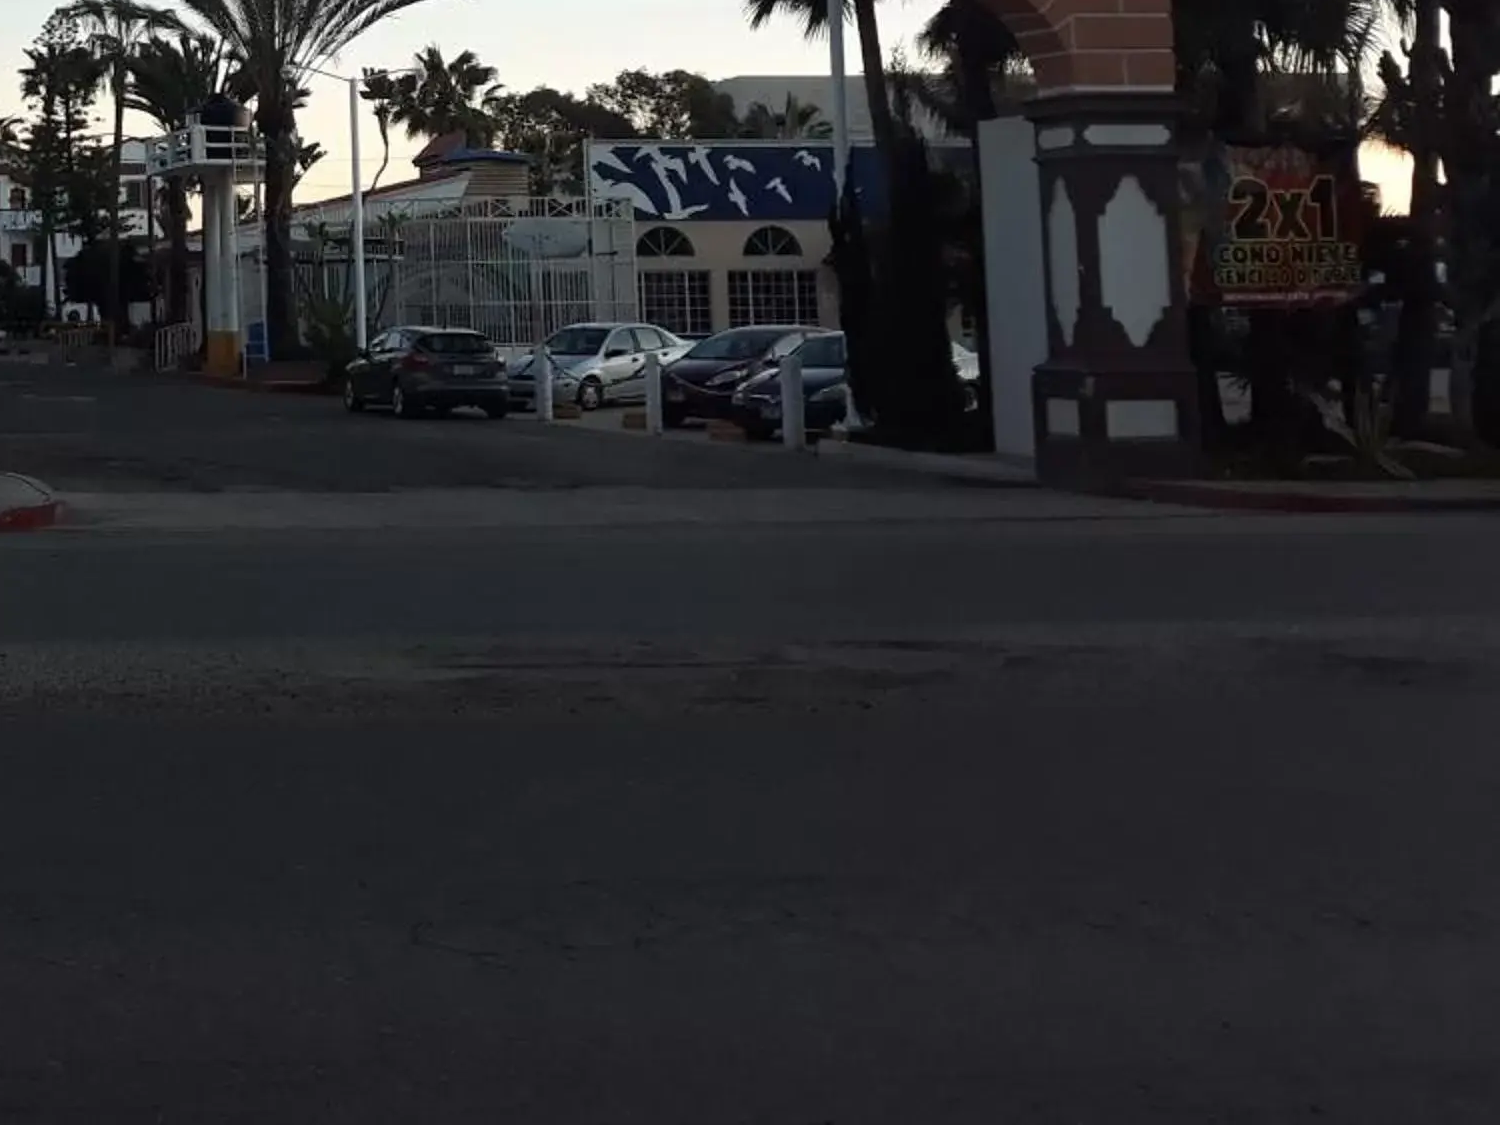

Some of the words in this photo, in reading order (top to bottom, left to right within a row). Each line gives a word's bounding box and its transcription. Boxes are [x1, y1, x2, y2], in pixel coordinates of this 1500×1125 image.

[1228, 175, 1337, 242] 2x1
[1218, 246, 1280, 263] CONO
[1291, 245, 1358, 263] NIEVE
